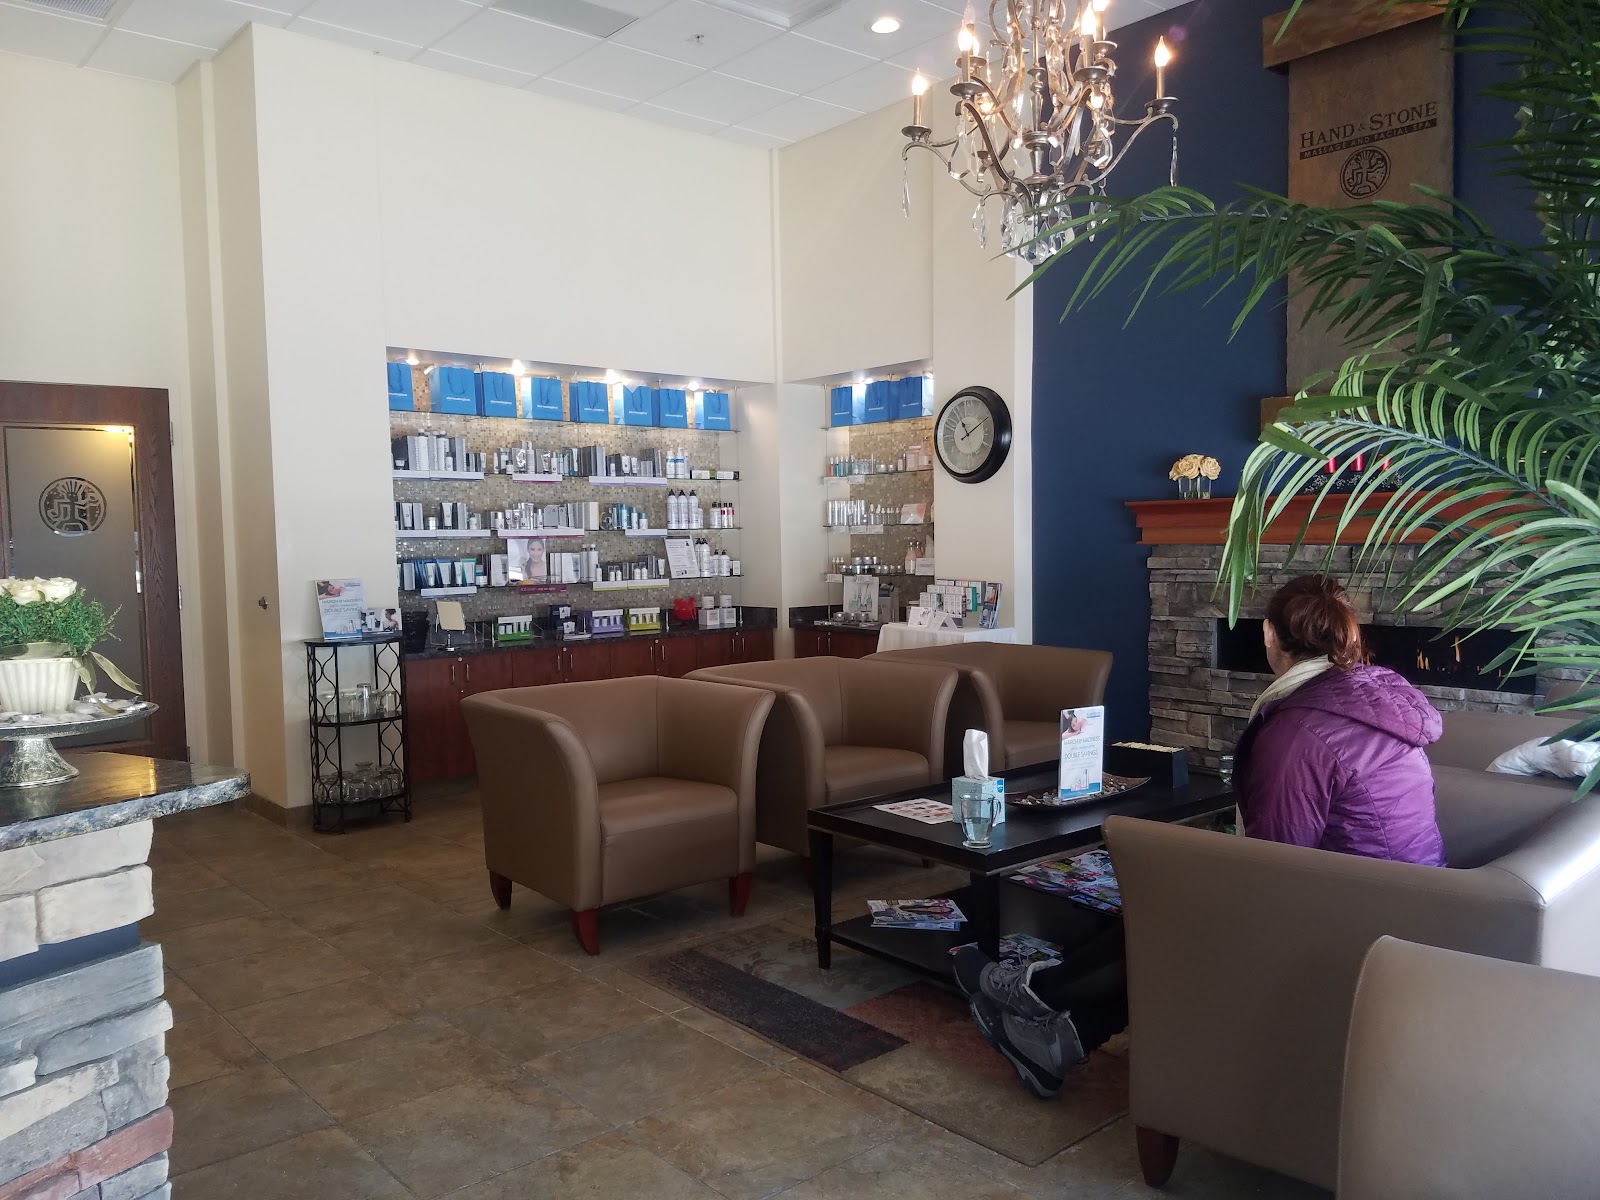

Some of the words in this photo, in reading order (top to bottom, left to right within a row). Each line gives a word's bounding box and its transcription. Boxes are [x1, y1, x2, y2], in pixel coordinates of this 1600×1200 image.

[1299, 124, 1355, 149] HAND
[1358, 123, 1367, 131] &
[1370, 101, 1438, 131] STONE
[1304, 142, 1348, 158] MASSAGE
[1350, 136, 1371, 147] AND
[1374, 126, 1409, 141] FACIAL
[1413, 120, 1431, 131] SPA
[1065, 751, 1081, 760] DOUBLE
